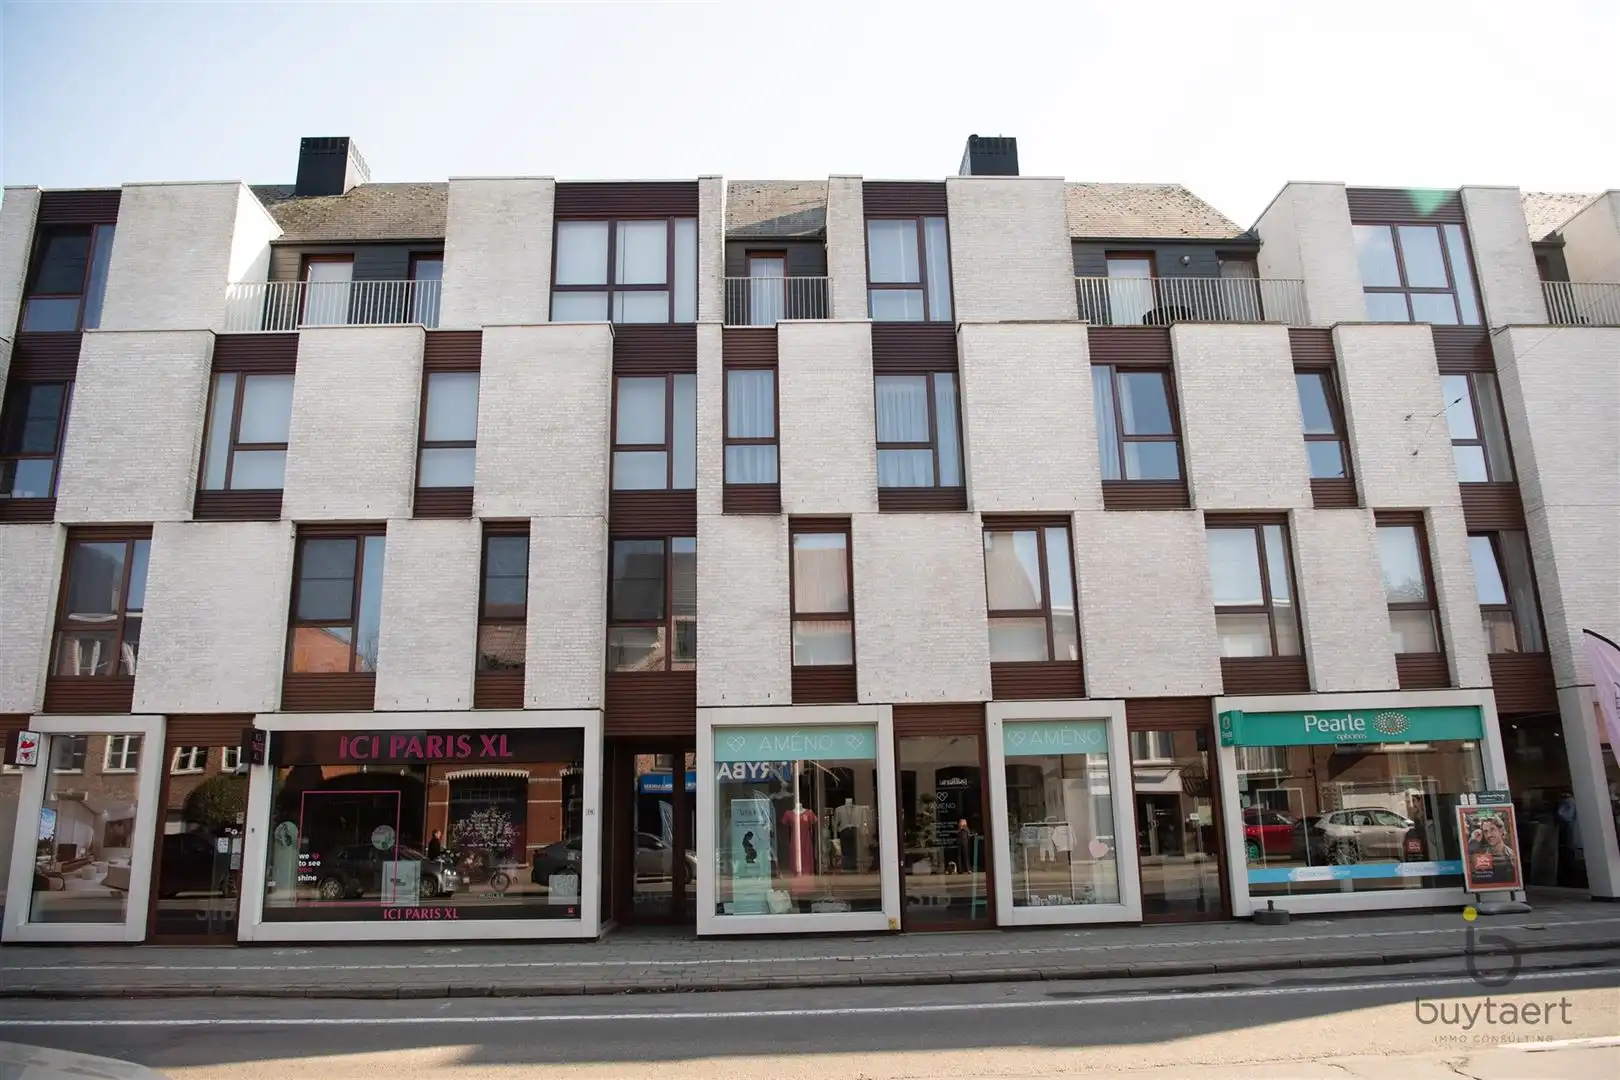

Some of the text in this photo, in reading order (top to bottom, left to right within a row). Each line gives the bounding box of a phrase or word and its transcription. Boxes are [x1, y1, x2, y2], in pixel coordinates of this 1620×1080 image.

[1303, 713, 1366, 733] Pearle
[338, 733, 513, 760] ICI PARIS XL
[759, 730, 833, 752] AMÉNO
[297, 874, 318, 882] shine
[383, 907, 459, 920] ICI PARIS XL
